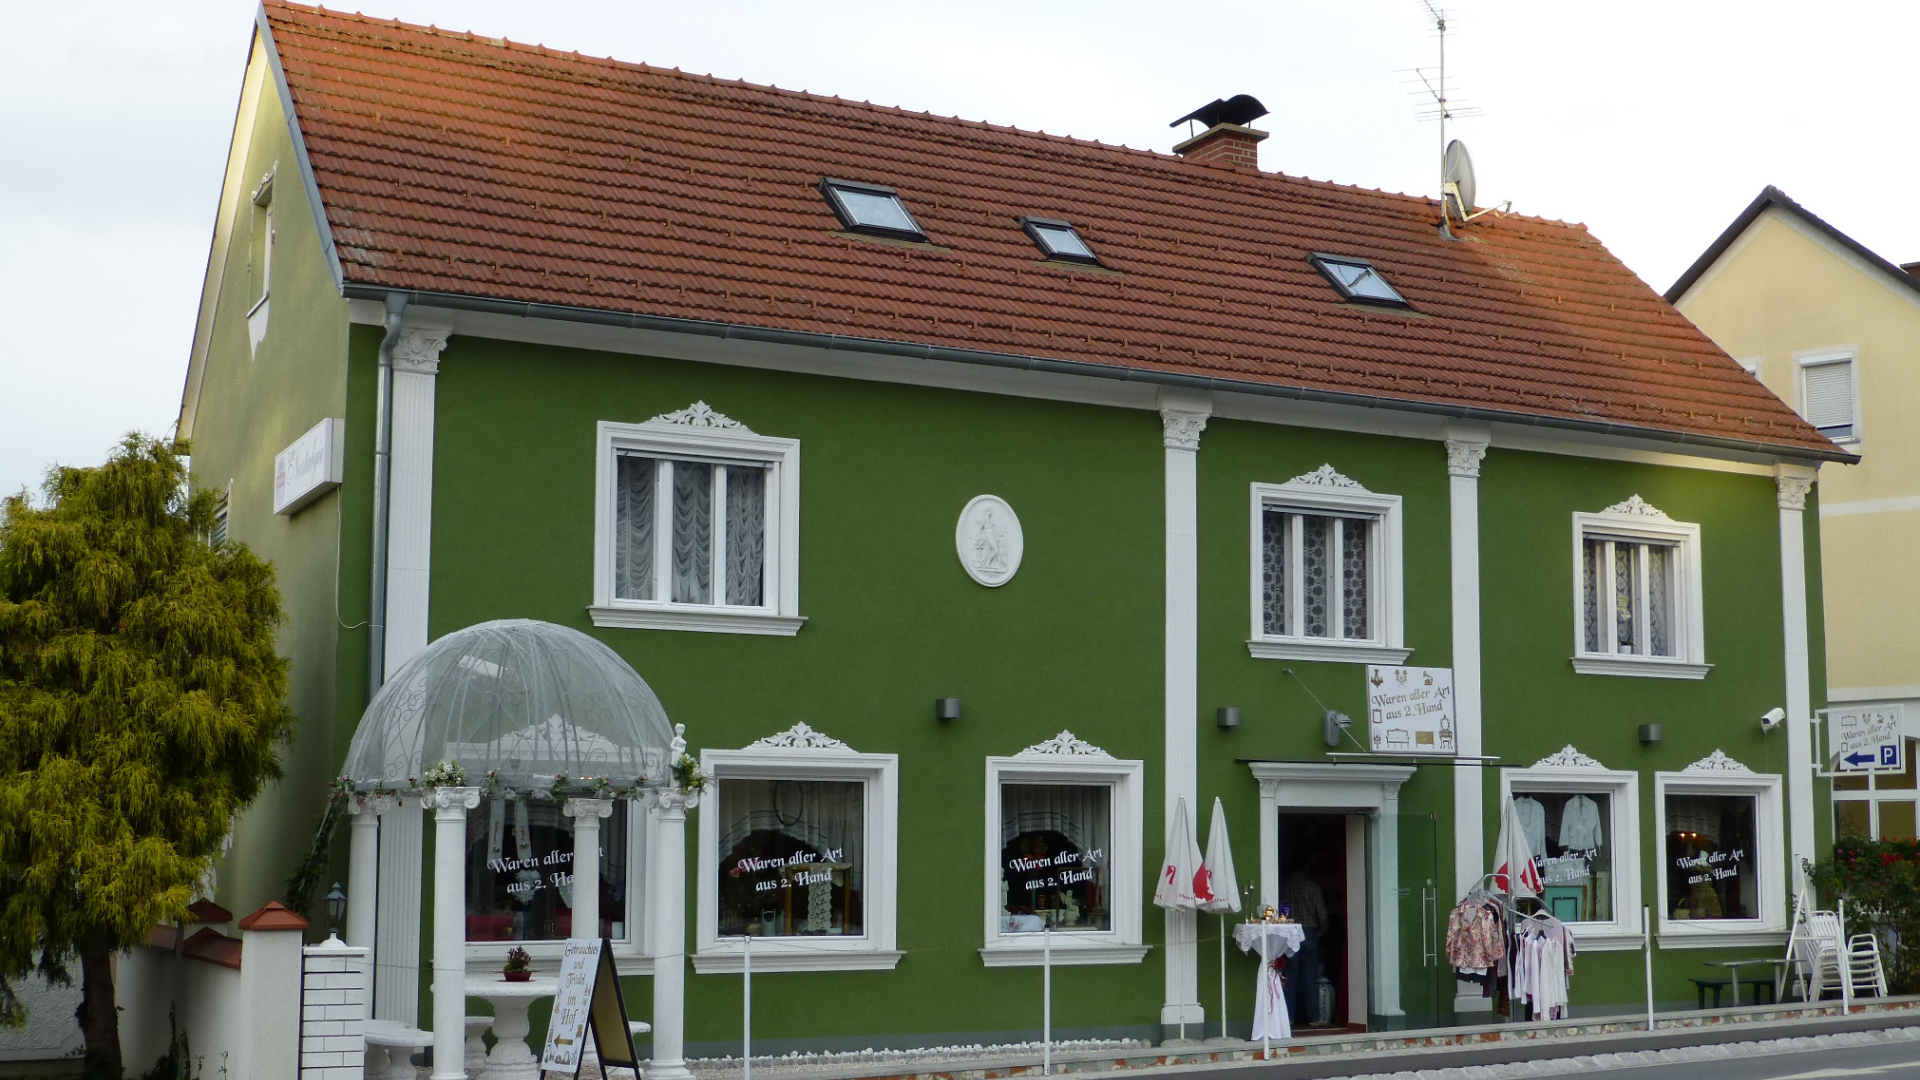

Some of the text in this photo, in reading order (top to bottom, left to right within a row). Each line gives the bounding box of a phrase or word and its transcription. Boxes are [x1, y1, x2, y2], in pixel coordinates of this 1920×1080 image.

[1371, 686, 1451, 707] Waren aller Art
[1386, 699, 1443, 720] aus 2. Hand
[1841, 720, 1897, 741] Waren aller Art
[1850, 741, 1862, 749] aus
[1871, 731, 1891, 744] Hand
[1883, 747, 1894, 763] P
[487, 849, 574, 874] Waren aller
[737, 847, 844, 873] Waren aller Art
[1009, 846, 1103, 873] Waren aller Art
[1559, 850, 1579, 863] aller
[1580, 848, 1598, 861] Art
[1676, 848, 1745, 870] Waren aller Art
[506, 871, 574, 894] aus 2. Ha
[755, 867, 833, 892] aus 2. Hand
[1025, 866, 1093, 890] aus 2. Hand
[1554, 874, 1563, 883] 2.
[1564, 864, 1591, 881] Hand
[1688, 864, 1738, 885] aus 2. Hand
[573, 957, 586, 970] und
[560, 1008, 579, 1032] Hof
